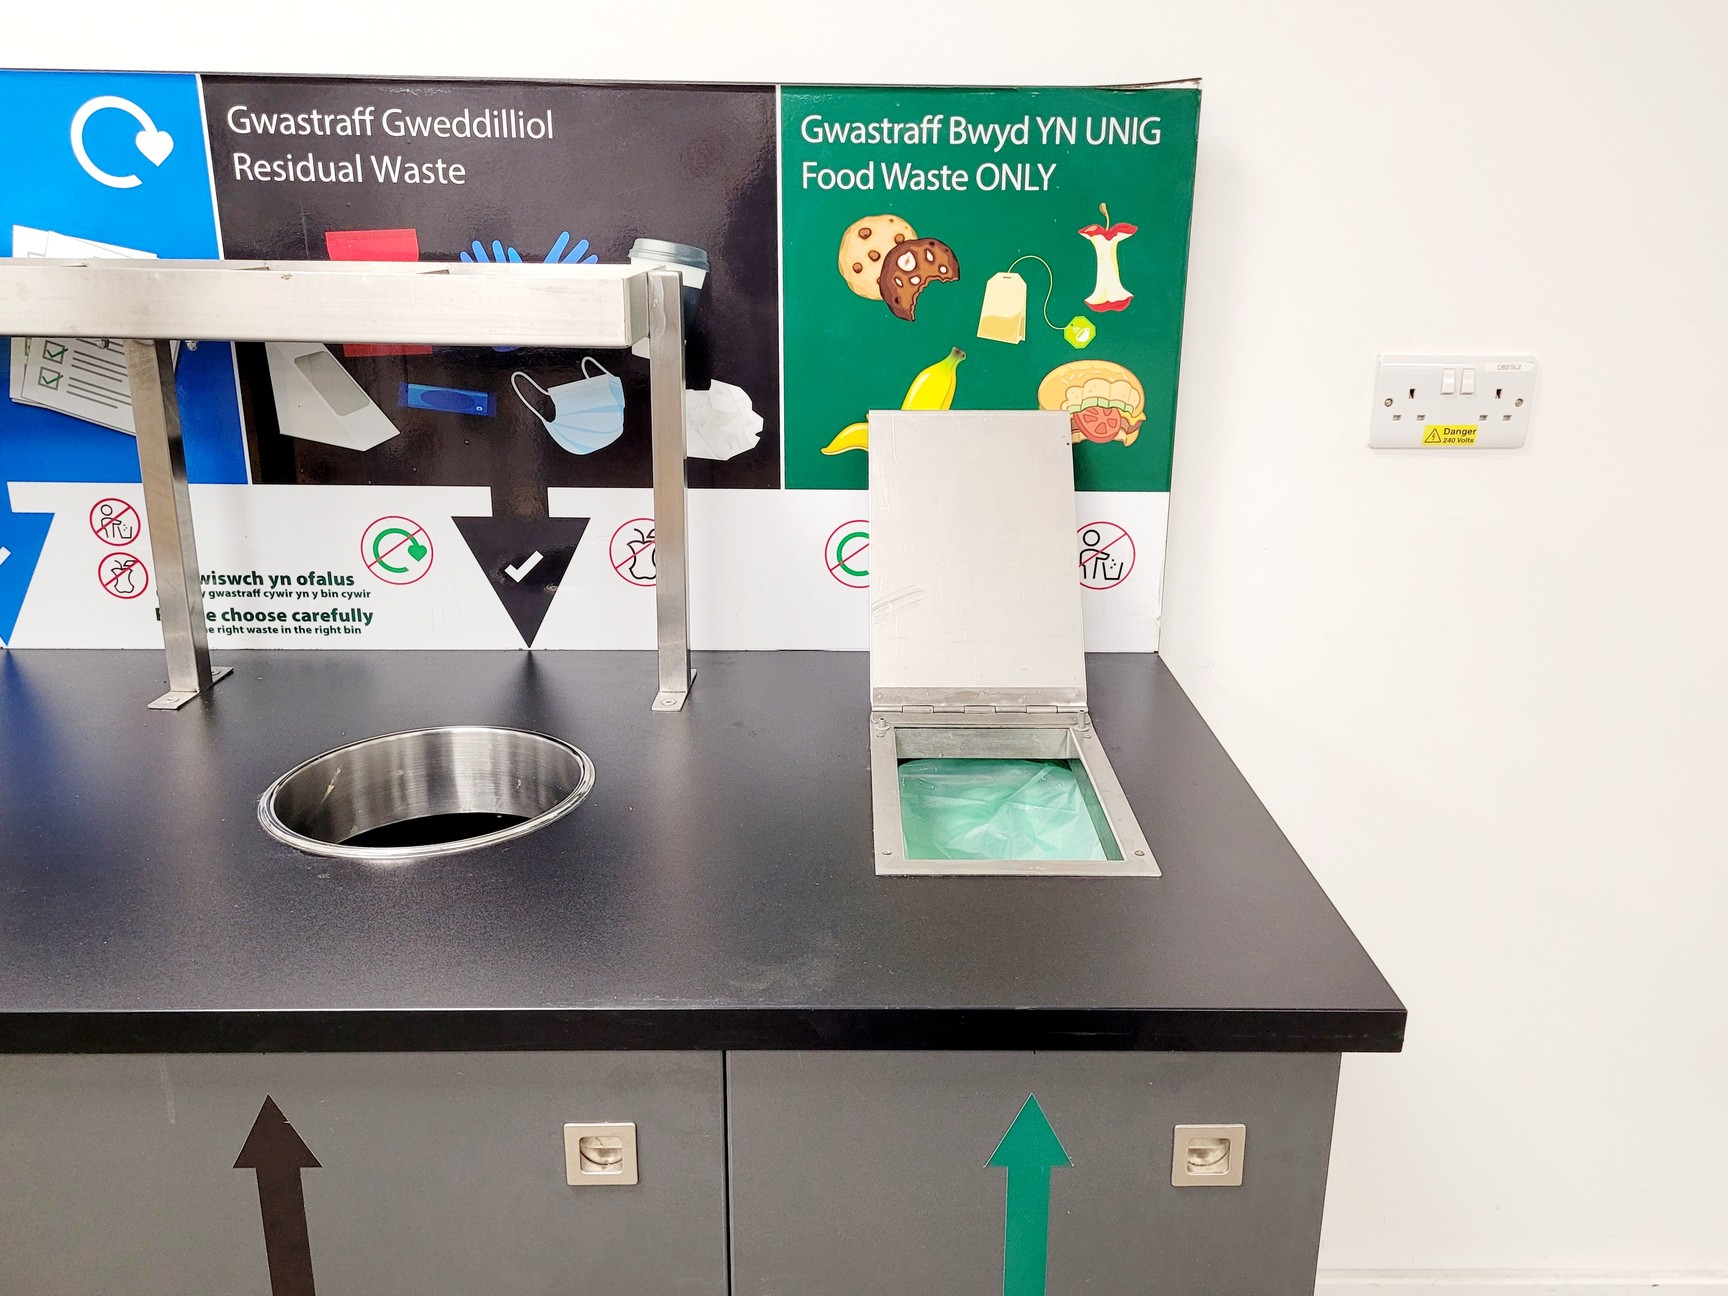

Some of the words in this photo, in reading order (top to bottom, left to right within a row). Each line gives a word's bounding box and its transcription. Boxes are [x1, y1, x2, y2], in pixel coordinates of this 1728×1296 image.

[227, 106, 374, 136] Gwastraff
[382, 108, 553, 139] Gweddilliol
[801, 114, 943, 144] Gwastraff
[949, 115, 1029, 153] Bwyd
[1035, 116, 1076, 145] YN
[1086, 116, 1161, 145] UNIG
[233, 152, 363, 183] Residual
[370, 155, 466, 185] Waste
[802, 161, 874, 190] Food
[881, 162, 968, 191] Waste
[975, 162, 1057, 191] ONLY
[1443, 427, 1477, 437] Danger
[200, 570, 264, 586] wiswch
[268, 574, 292, 589] yn
[296, 571, 355, 586] ofalus
[208, 589, 261, 600] gwastraff
[263, 589, 293, 600] cywir
[296, 591, 310, 600] yn
[312, 591, 319, 600] y
[320, 589, 339, 598] bin
[341, 589, 371, 600] cywir
[221, 607, 287, 622] choose
[292, 608, 374, 626] carefully
[217, 625, 244, 636] right
[246, 625, 279, 634] waste
[281, 625, 292, 634] in
[294, 625, 312, 634] the
[314, 625, 342, 636] right
[344, 625, 362, 634] bin
